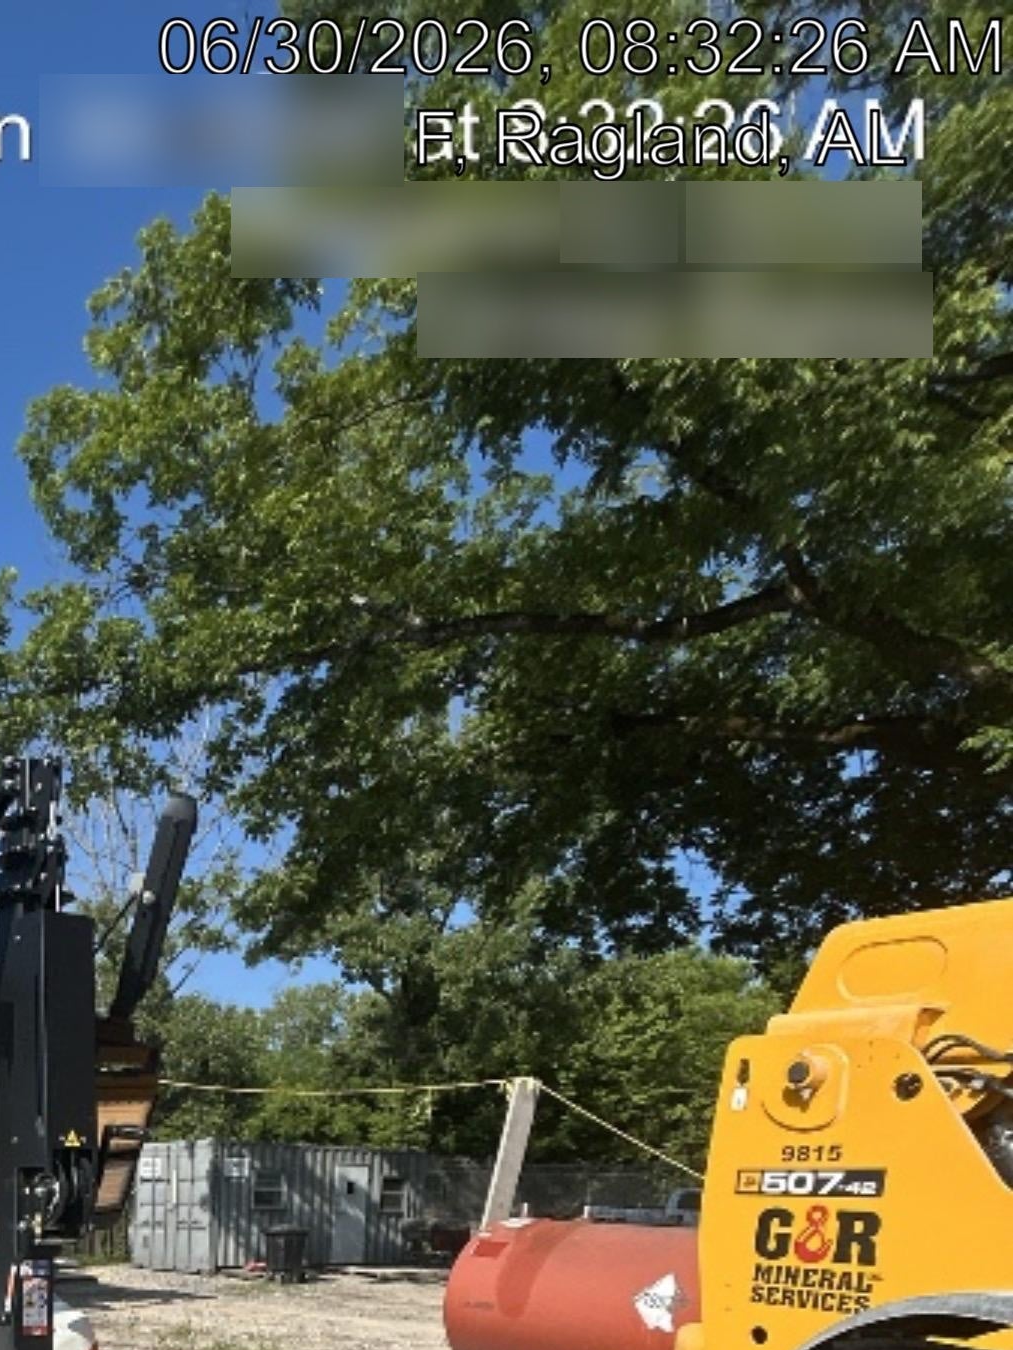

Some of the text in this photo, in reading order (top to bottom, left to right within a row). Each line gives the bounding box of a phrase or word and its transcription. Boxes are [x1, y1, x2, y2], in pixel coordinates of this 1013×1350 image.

[781, 1145, 842, 1162] 9815
[755, 1205, 882, 1266] G&R
[752, 1263, 874, 1293] MINERAL
[751, 1283, 870, 1314] SERVICES
